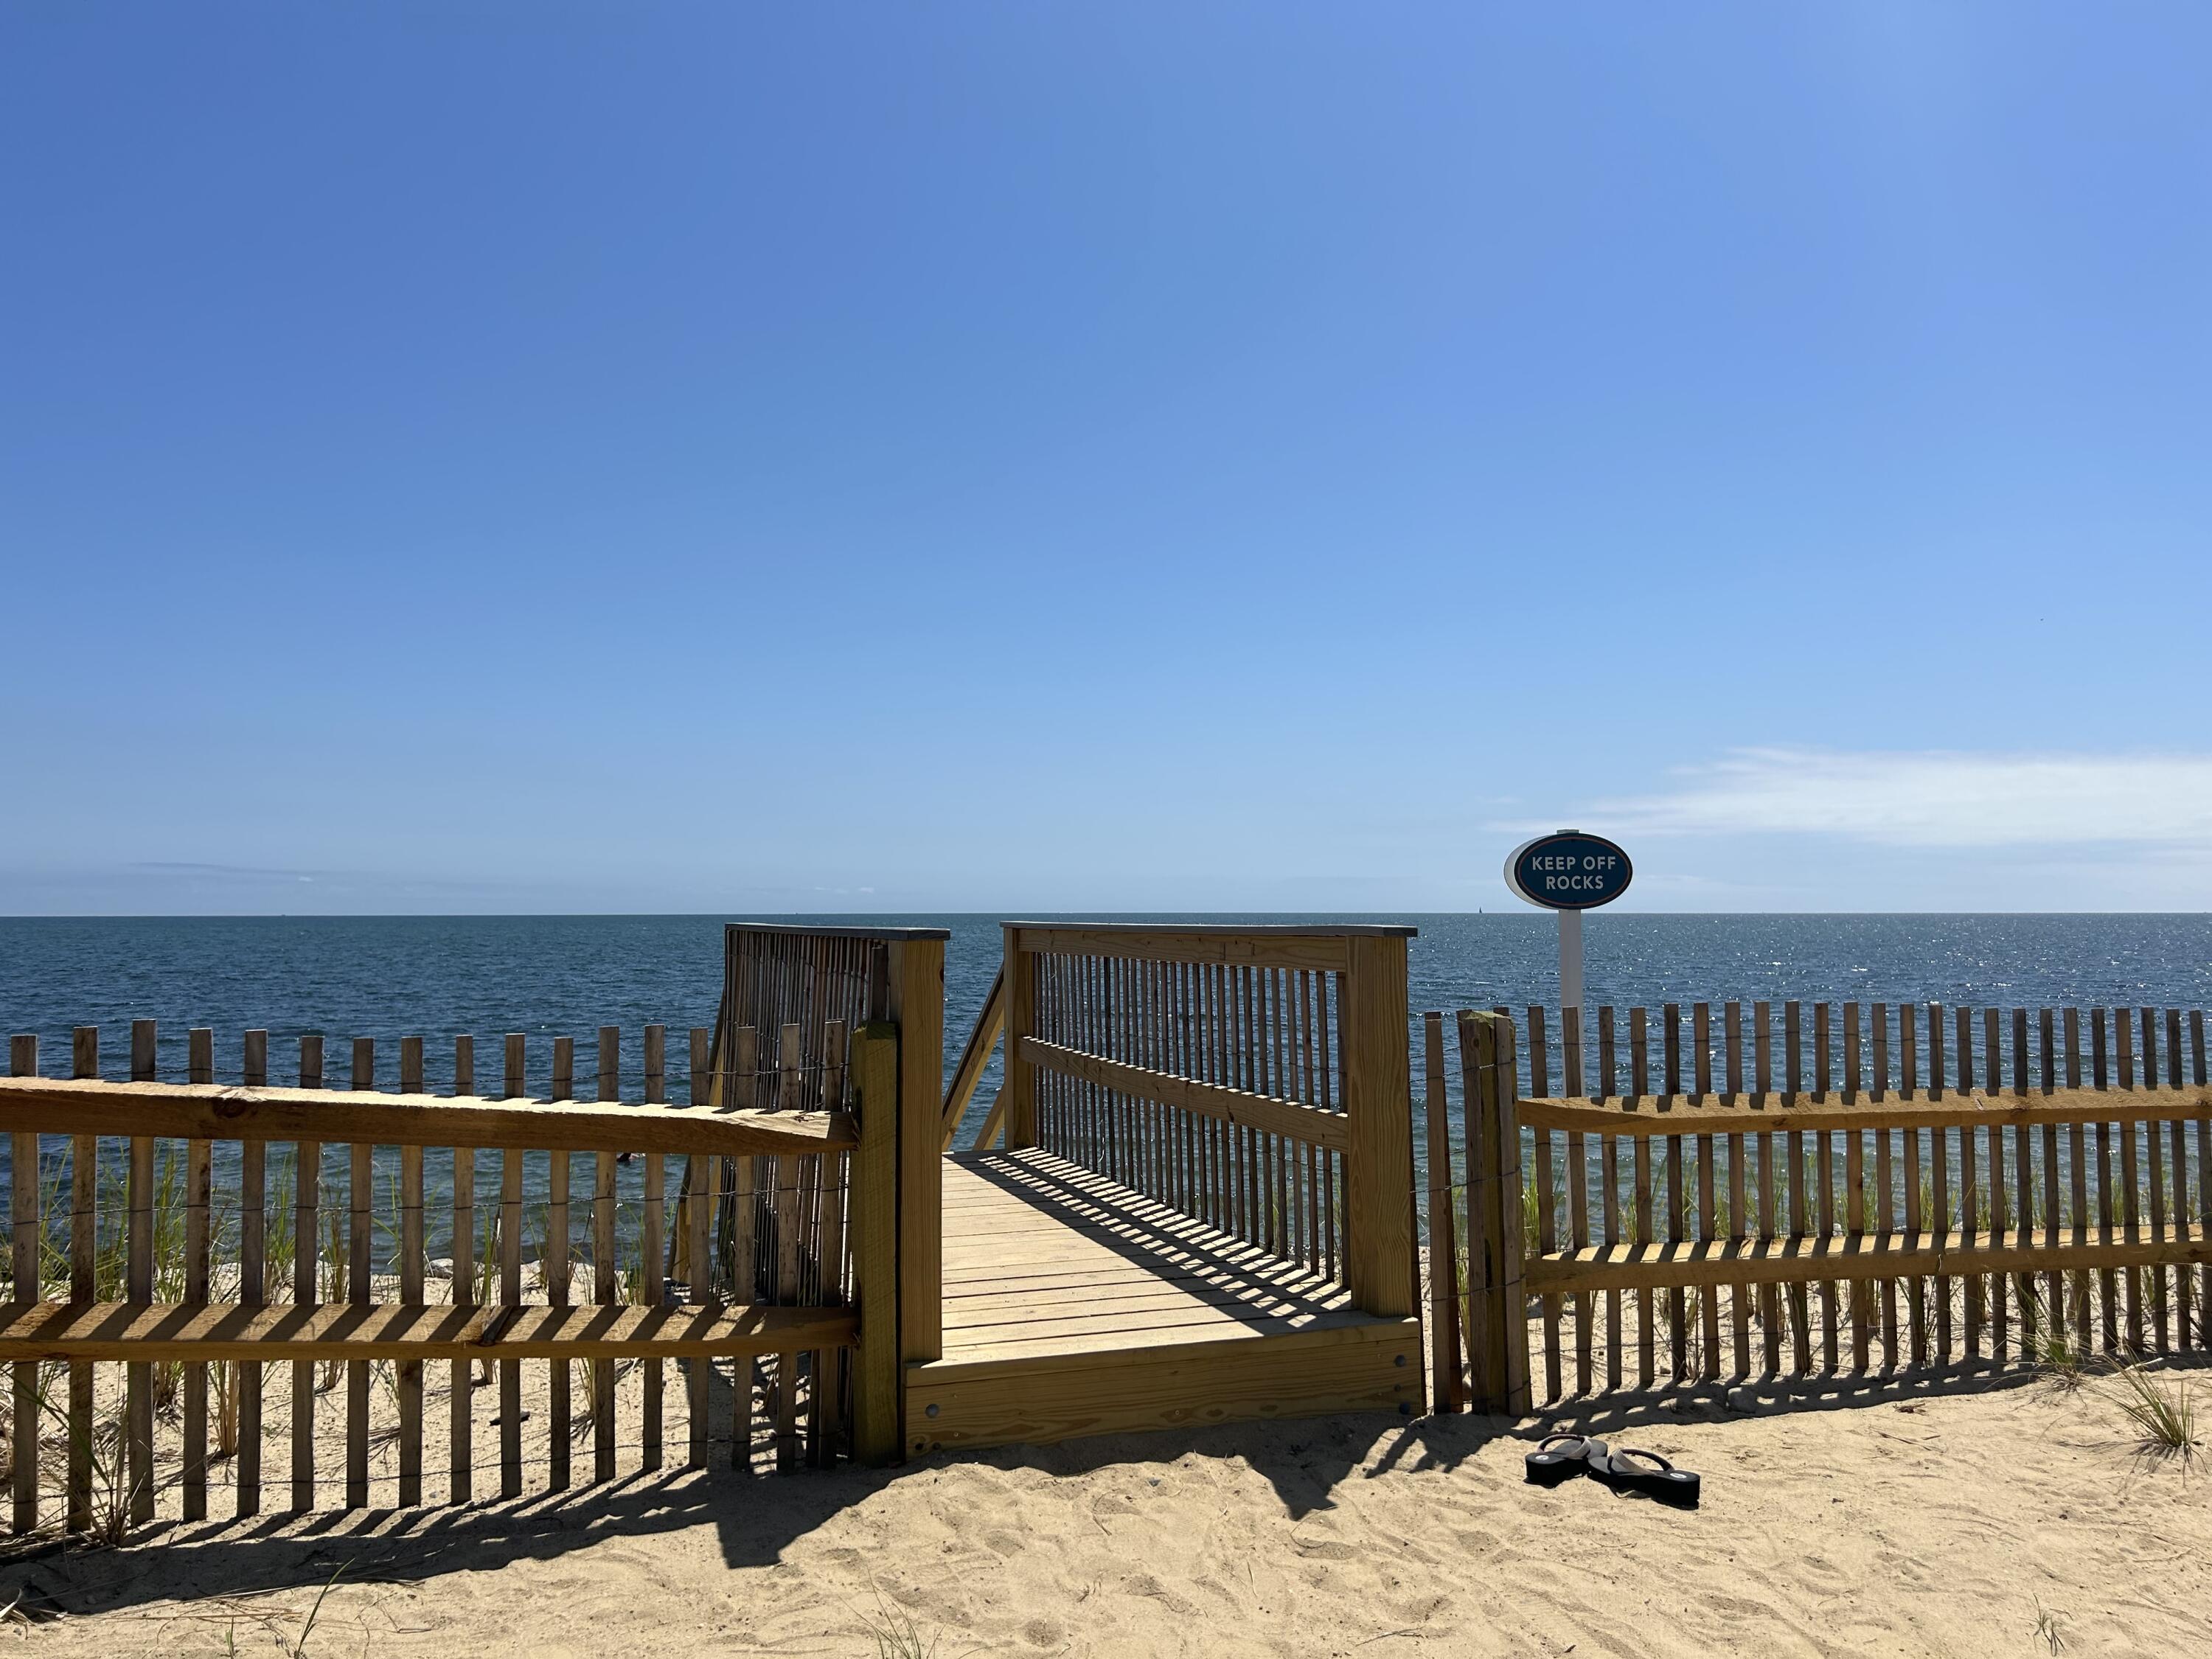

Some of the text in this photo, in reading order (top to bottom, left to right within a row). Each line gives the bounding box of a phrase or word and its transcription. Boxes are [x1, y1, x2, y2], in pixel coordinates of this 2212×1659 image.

[1532, 855, 1616, 871] KEEP OFF
[1545, 875, 1604, 890] ROCKS
